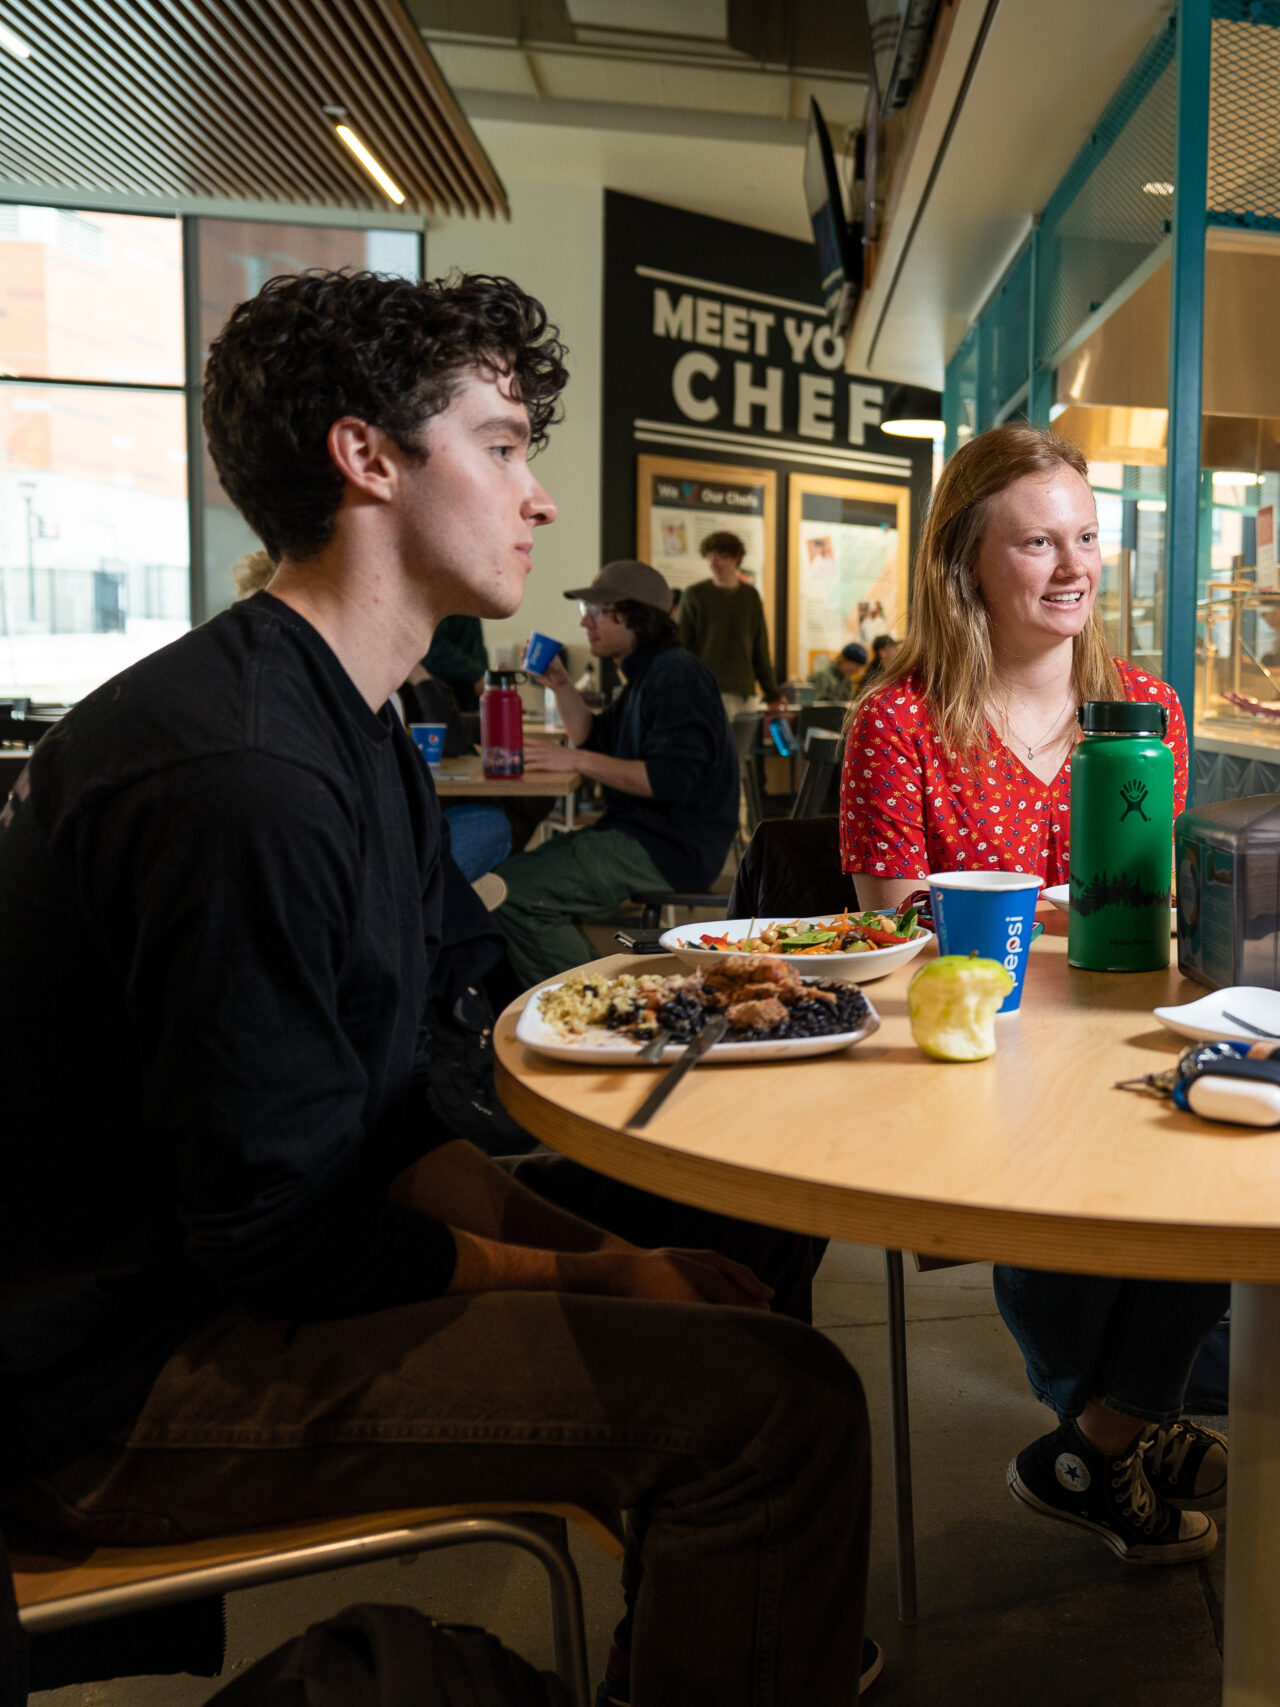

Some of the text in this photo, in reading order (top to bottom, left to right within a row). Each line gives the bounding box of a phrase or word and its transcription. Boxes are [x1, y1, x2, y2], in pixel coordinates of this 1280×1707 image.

[653, 287, 775, 357] MEET
[672, 350, 884, 446] CHEF
[657, 483, 759, 508] We Our Chefs
